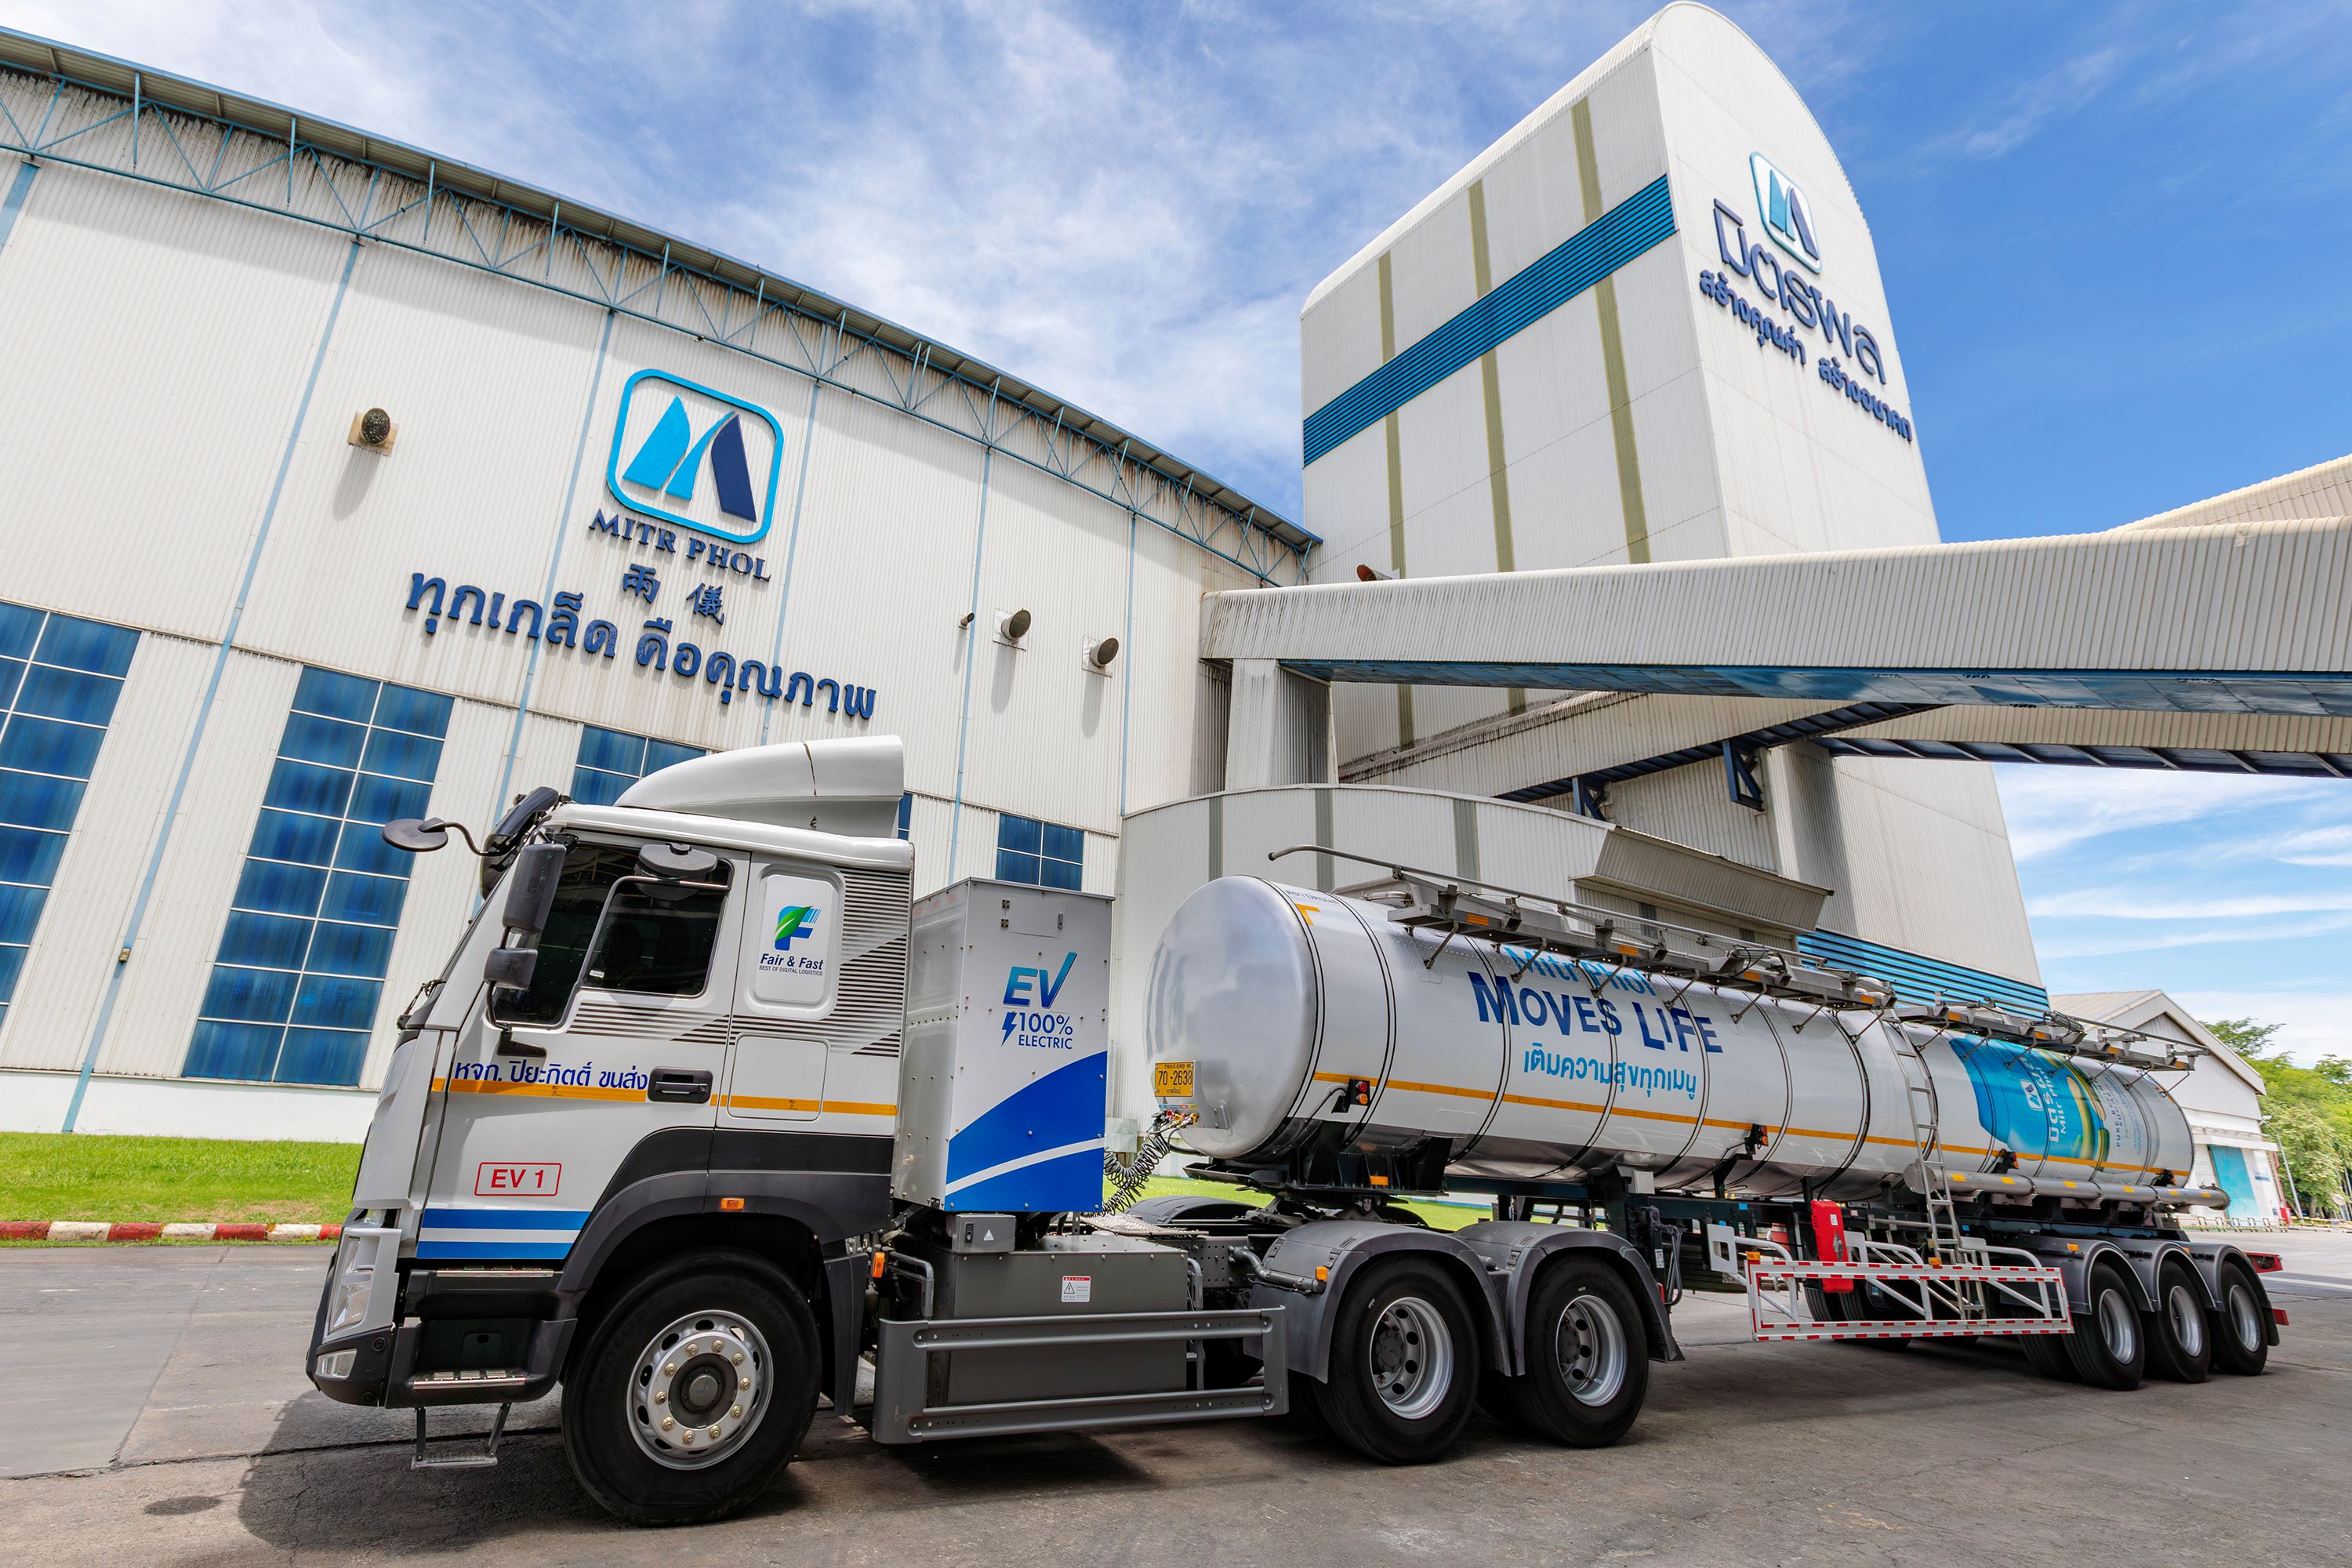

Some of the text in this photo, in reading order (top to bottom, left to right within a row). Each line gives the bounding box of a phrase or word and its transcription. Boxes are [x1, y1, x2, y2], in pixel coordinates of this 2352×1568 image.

[1700, 270, 1914, 443] สร้างคุณค่า สร้างอนาคต
[589, 508, 771, 583] MITR PHOL
[405, 571, 877, 720] ทุกเกล็ด คือคุณภาพ
[760, 953, 825, 970] Fair & Fast
[1003, 952, 1077, 1009] EV
[1504, 946, 1657, 996] Mitr Phol
[1018, 1011, 1074, 1036] 100%
[1467, 971, 1725, 1054] MOVES LIFE
[1018, 1033, 1073, 1051] ELECTRIC
[455, 1058, 648, 1091] หจก. ปิยะกิตติ์ ขนส่ง
[1523, 1041, 1698, 1101] เติมความสุขทุกเมนู
[490, 1169, 545, 1189] EV 1
